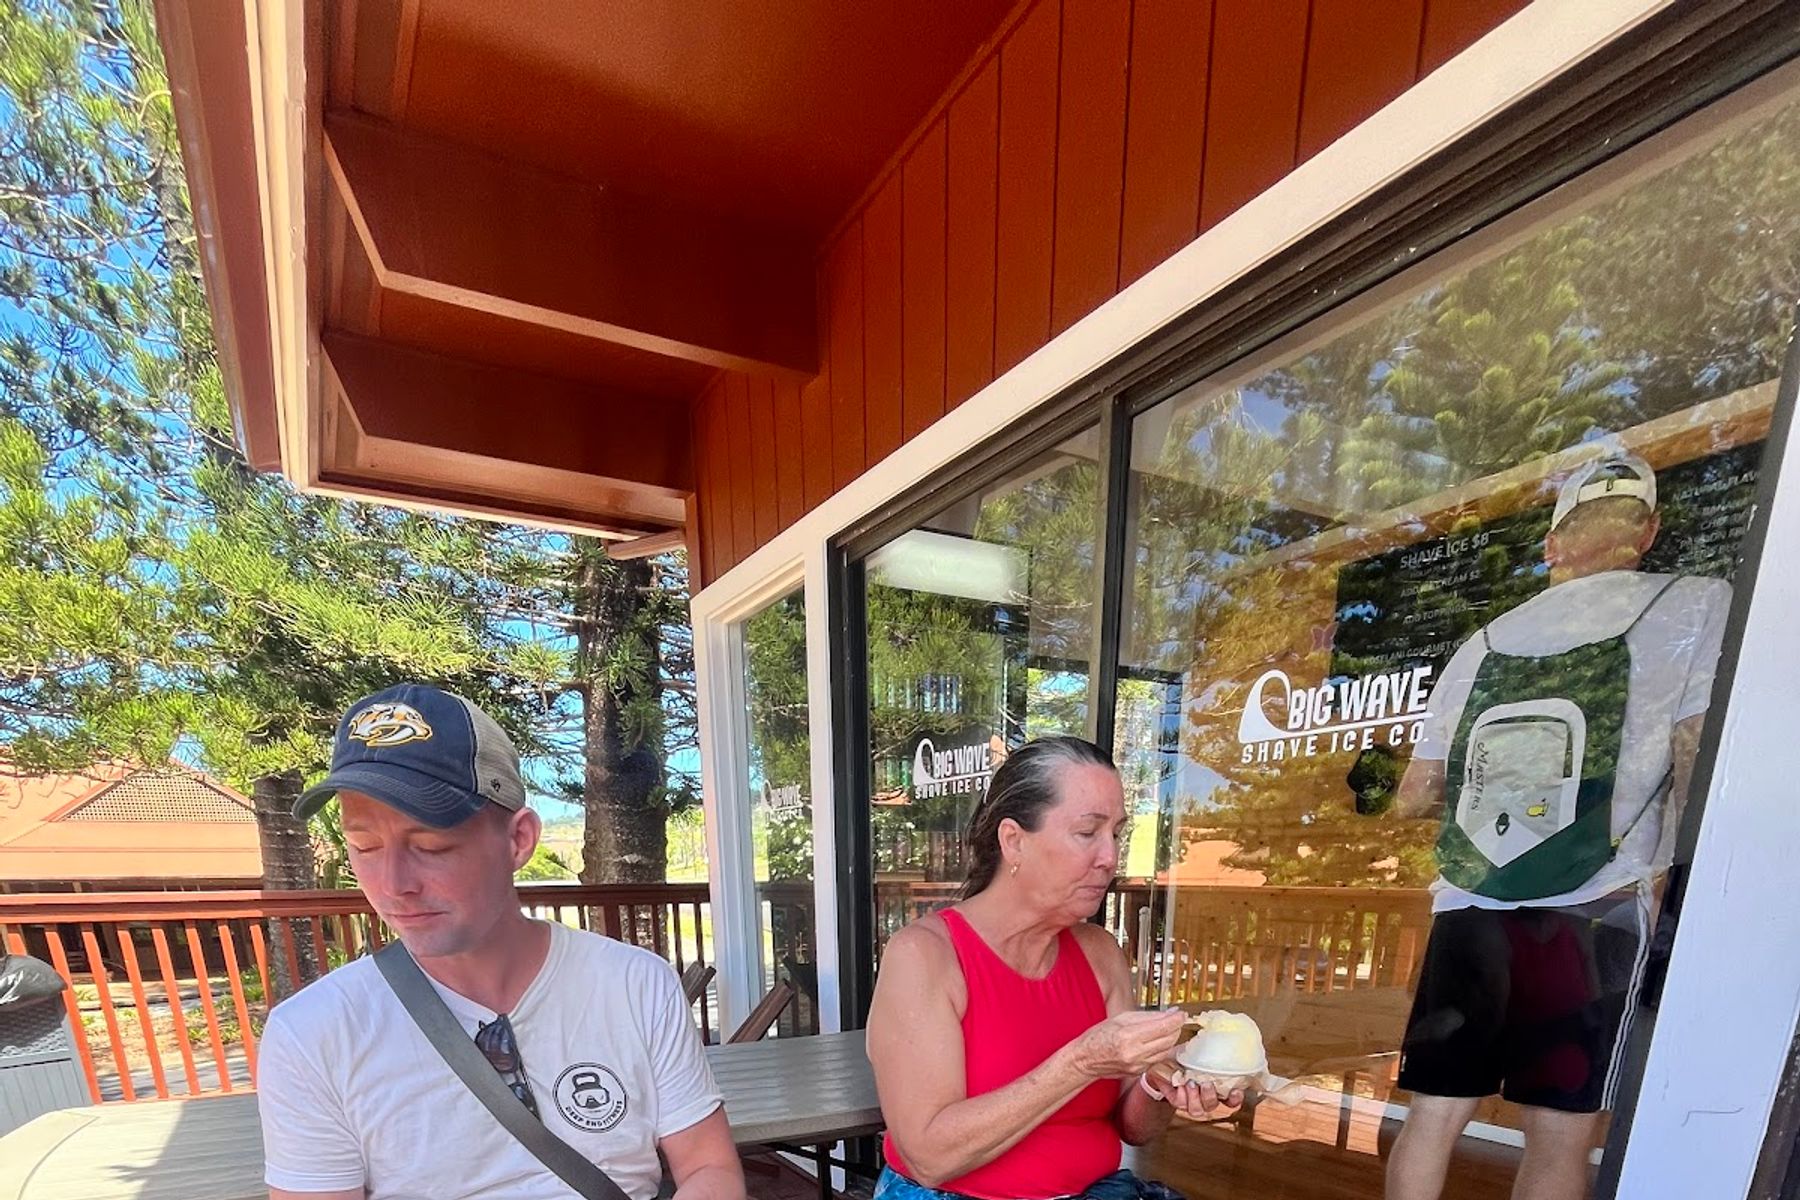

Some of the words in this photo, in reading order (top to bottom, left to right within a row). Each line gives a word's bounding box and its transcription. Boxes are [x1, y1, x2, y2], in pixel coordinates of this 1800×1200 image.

[1400, 545, 1445, 569] SHAVE
[1446, 537, 1469, 558] ICE
[1287, 684, 1335, 731] BIG
[1340, 665, 1432, 721] WAVE
[1241, 733, 1319, 764] SHAVE
[1330, 727, 1376, 754] ICE
[1389, 720, 1430, 747] CO.
[934, 749, 953, 779] BIG
[954, 742, 990, 774] WAVE
[915, 781, 948, 800] SHAVE
[952, 779, 971, 794] ICE
[565, 1106, 584, 1122] DEEP
